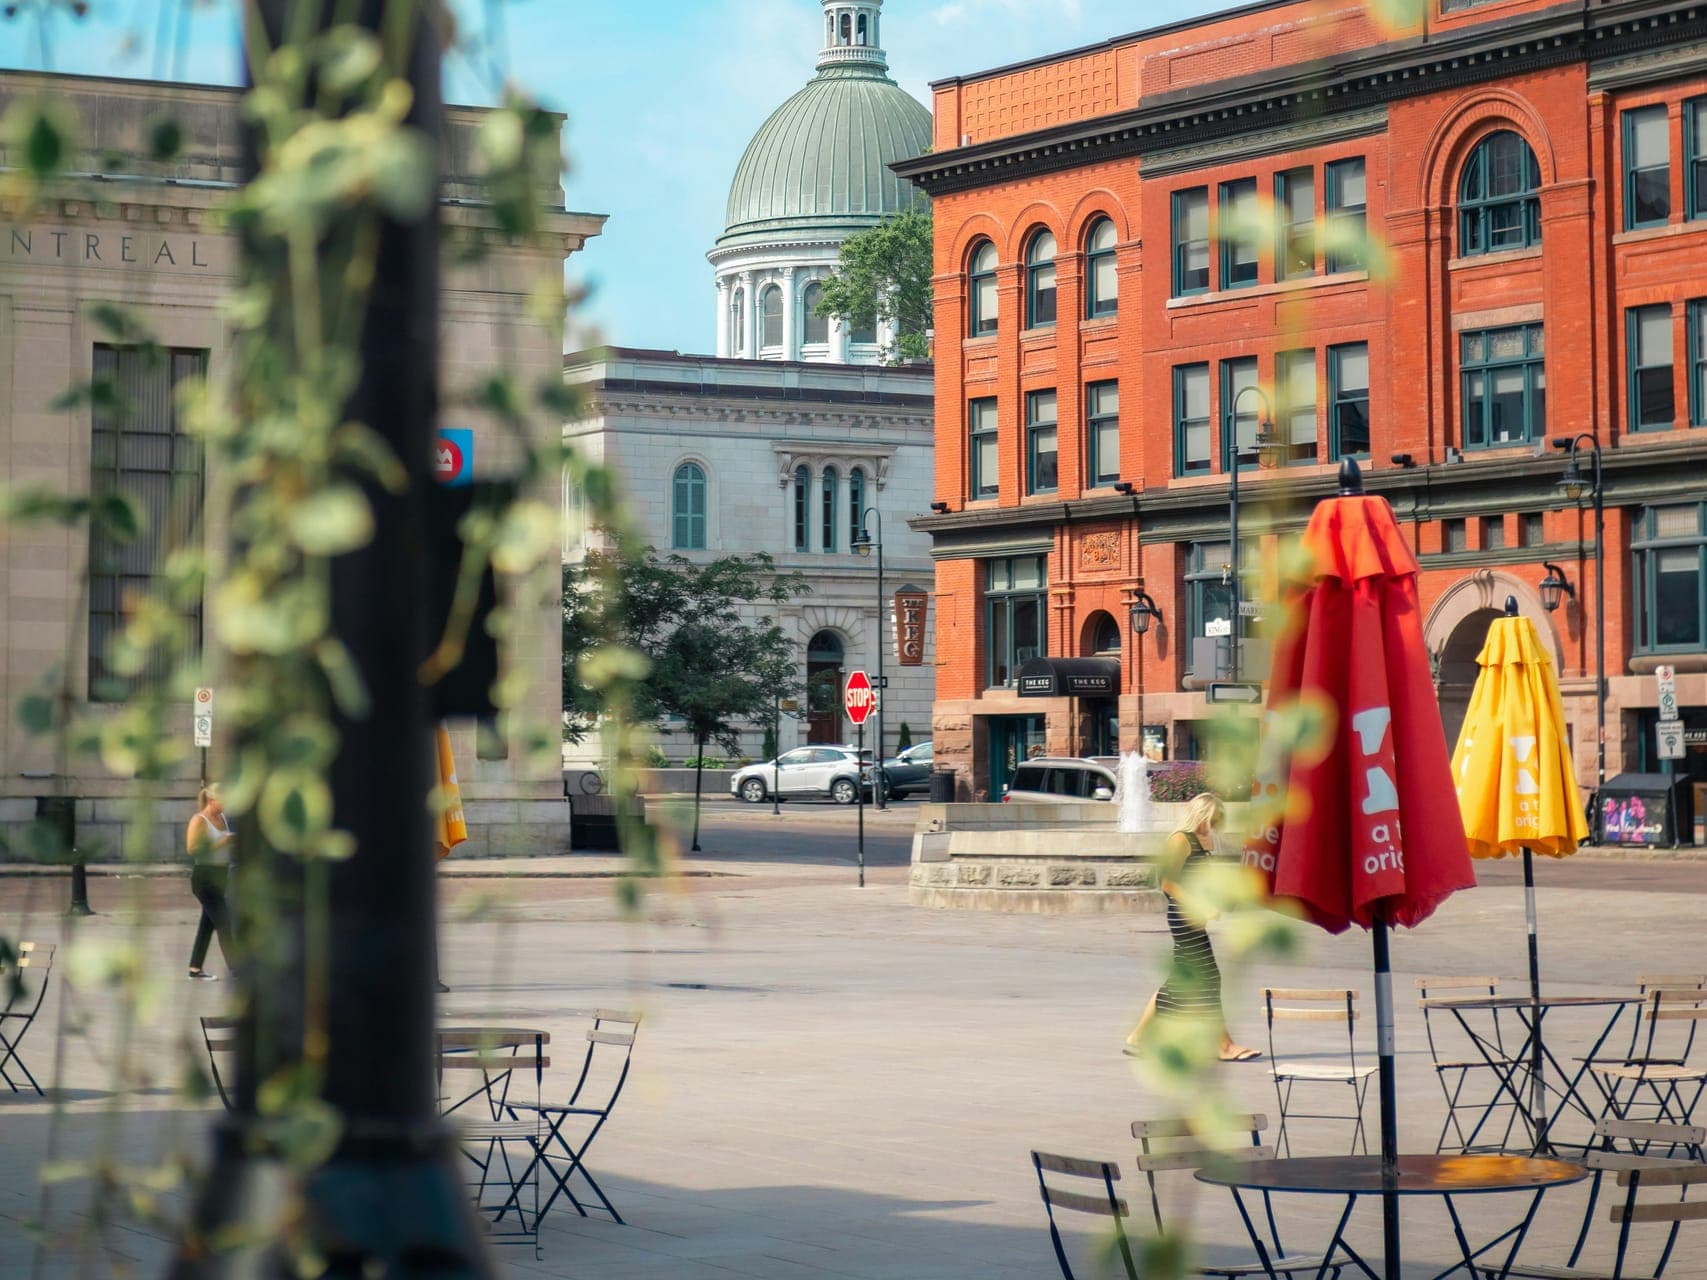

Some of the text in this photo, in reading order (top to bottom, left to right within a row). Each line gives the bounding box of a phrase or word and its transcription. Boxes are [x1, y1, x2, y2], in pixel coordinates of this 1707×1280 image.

[11, 229, 208, 267] NTREAL
[903, 608, 920, 657] KEG
[847, 688, 869, 707] STOP
